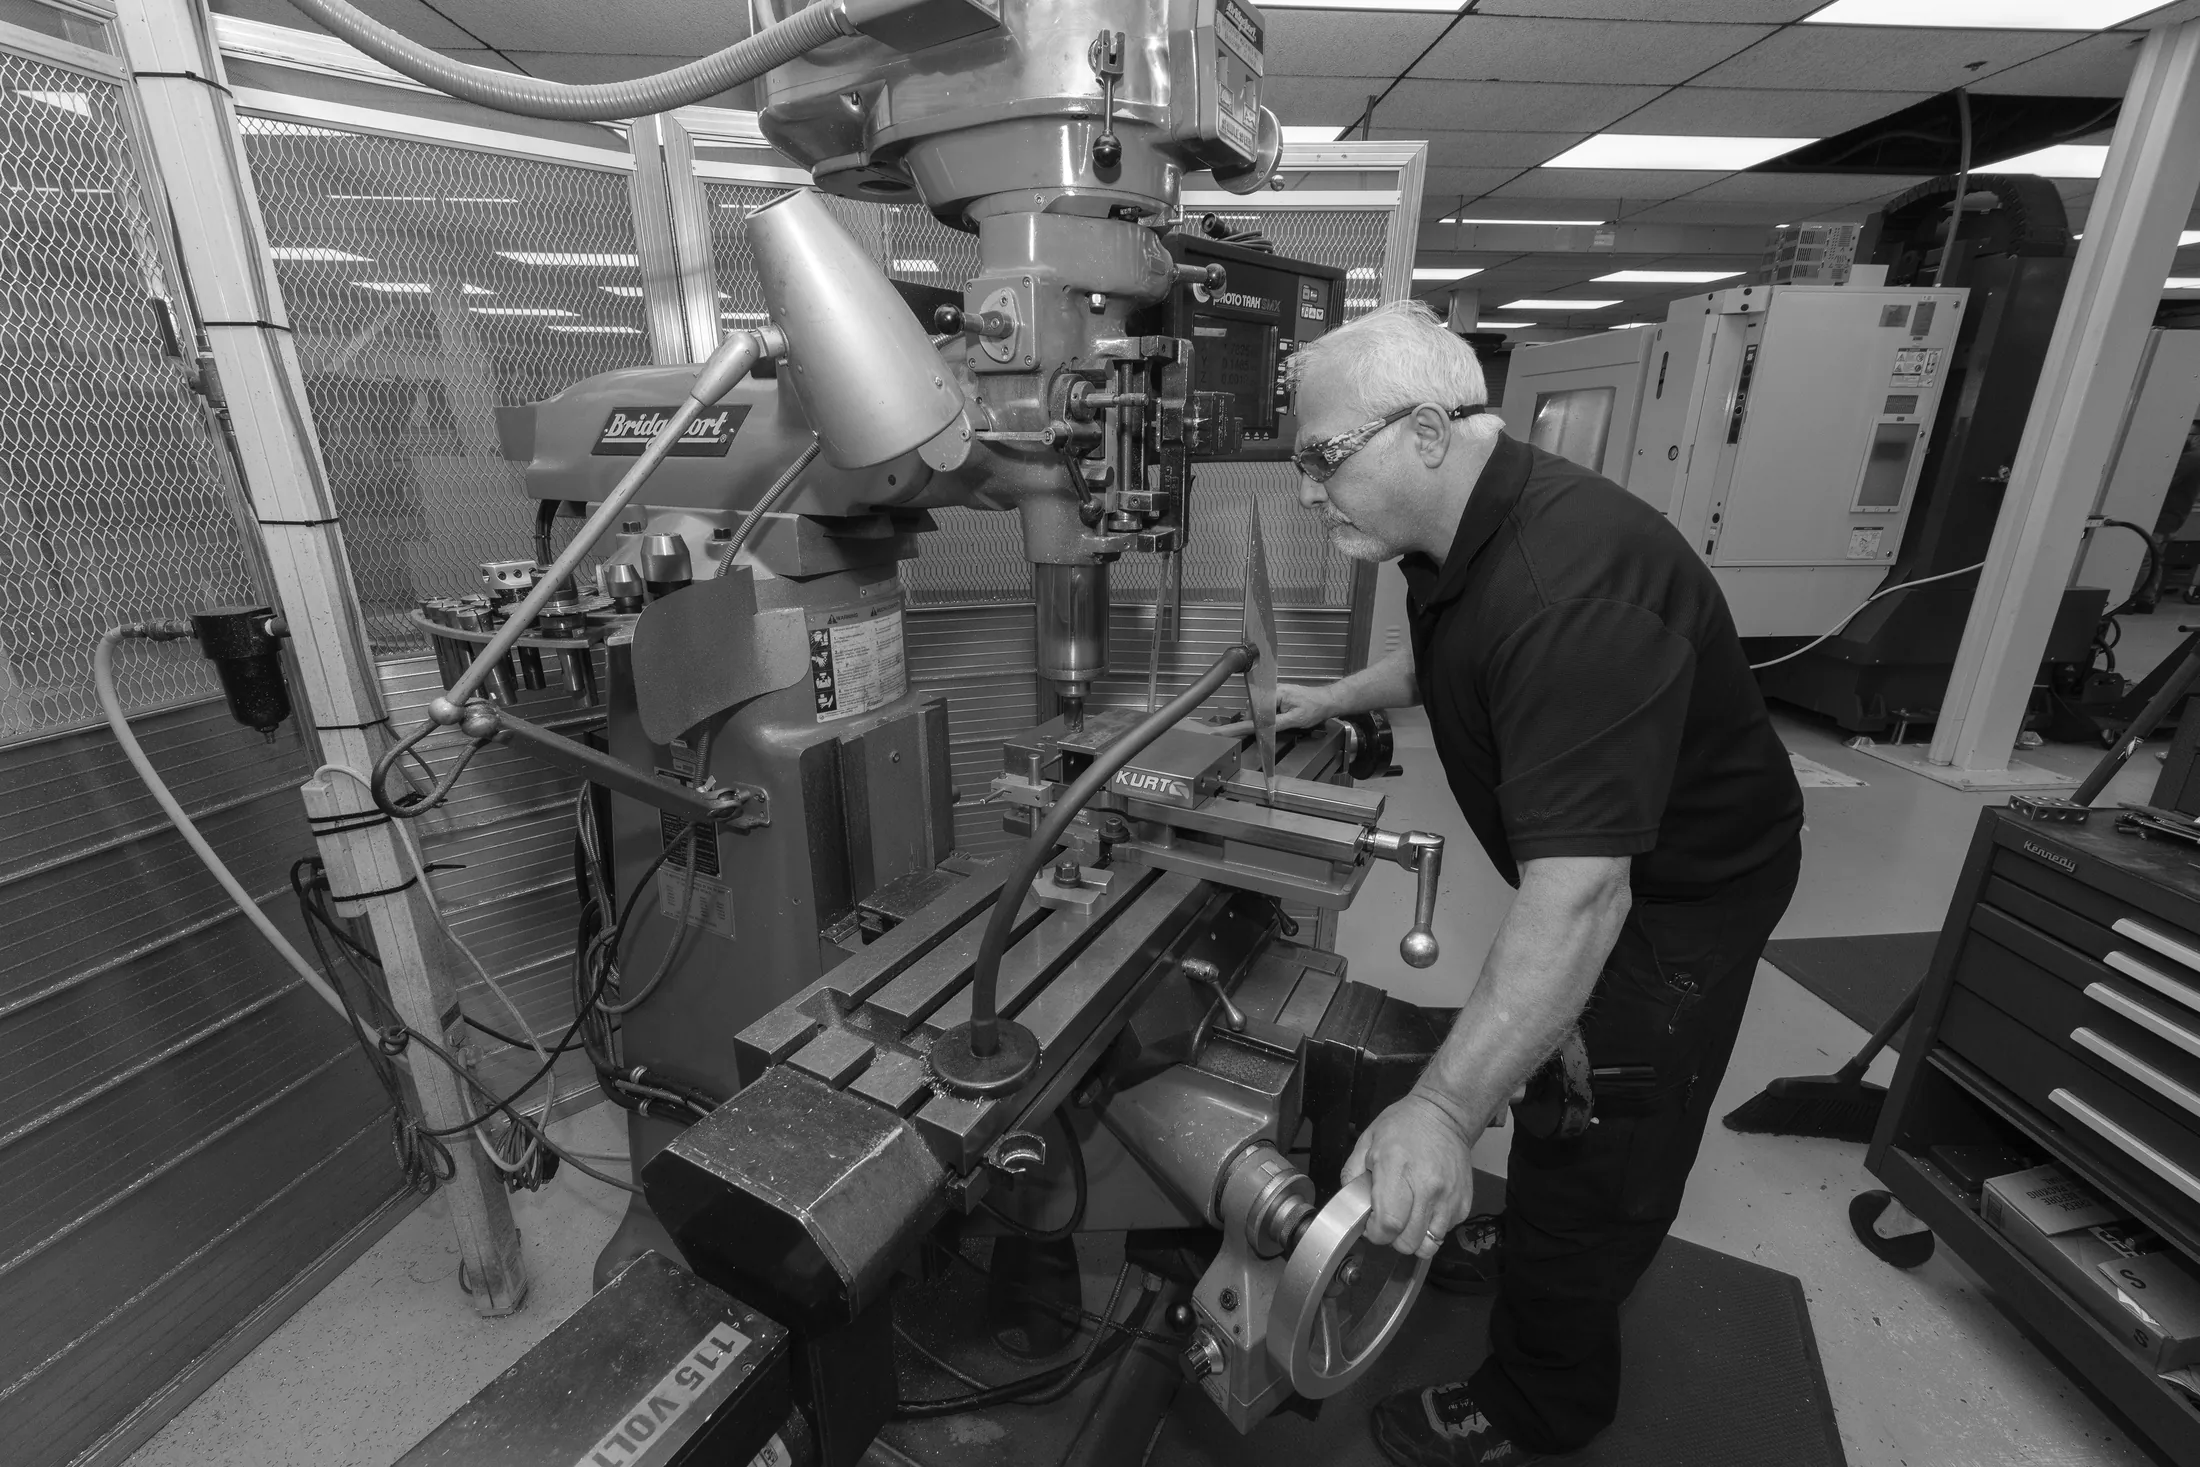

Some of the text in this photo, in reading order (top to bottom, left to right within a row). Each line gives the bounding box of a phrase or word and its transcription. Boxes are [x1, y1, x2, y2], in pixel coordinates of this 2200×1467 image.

[604, 412, 728, 450] Bridgort
[1115, 770, 1173, 792] KURT
[2023, 840, 2076, 873] Kennedy
[674, 1336, 736, 1391] 115
